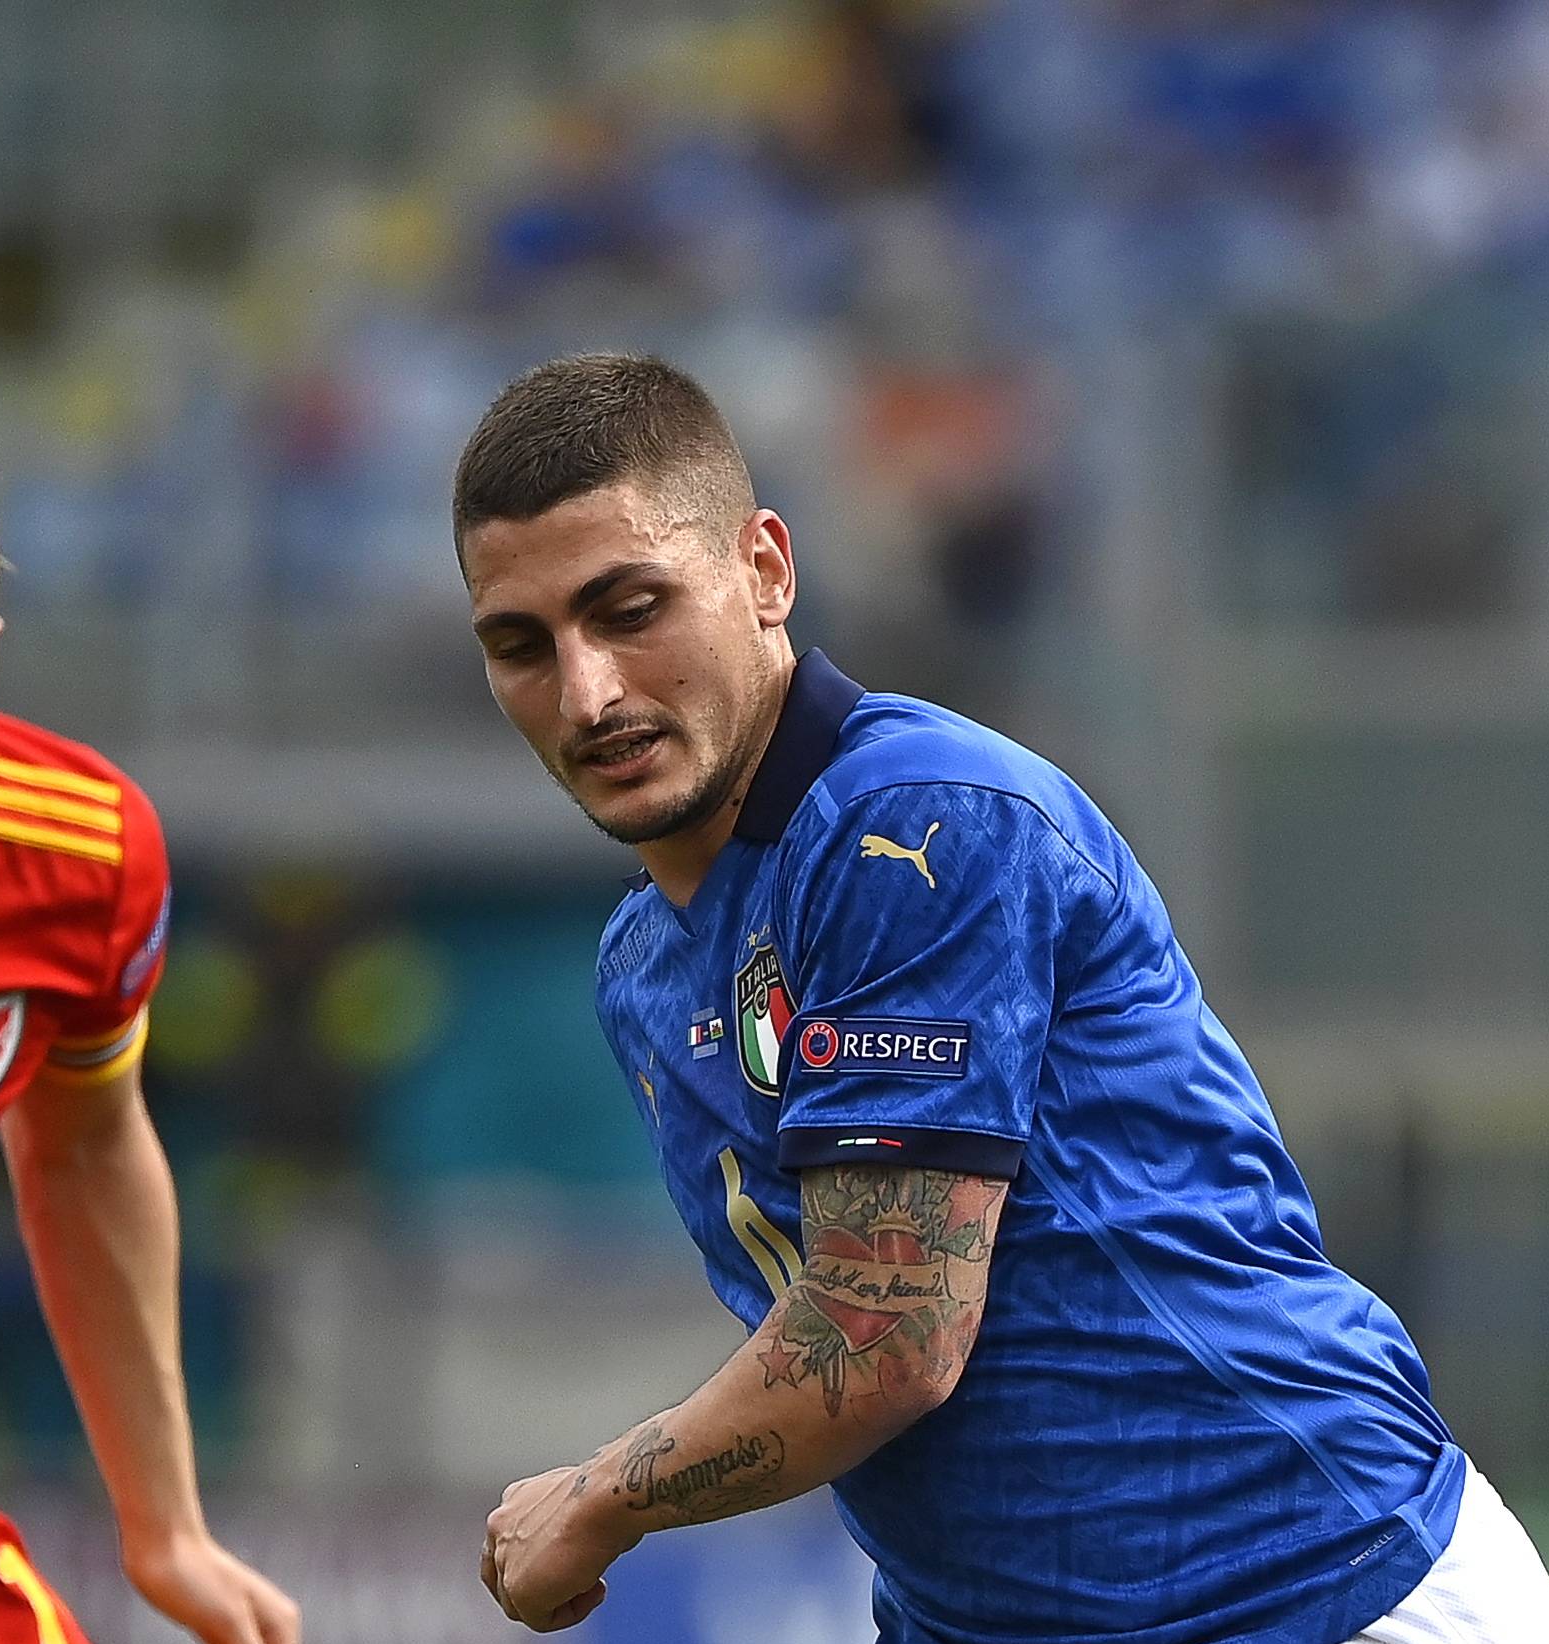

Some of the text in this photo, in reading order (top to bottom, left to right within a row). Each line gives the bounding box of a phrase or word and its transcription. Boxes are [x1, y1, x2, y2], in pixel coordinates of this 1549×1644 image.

[741, 953, 780, 1000] ITALIA
[807, 1023, 831, 1036] UEFA
[843, 1033, 968, 1062] RESPECT
